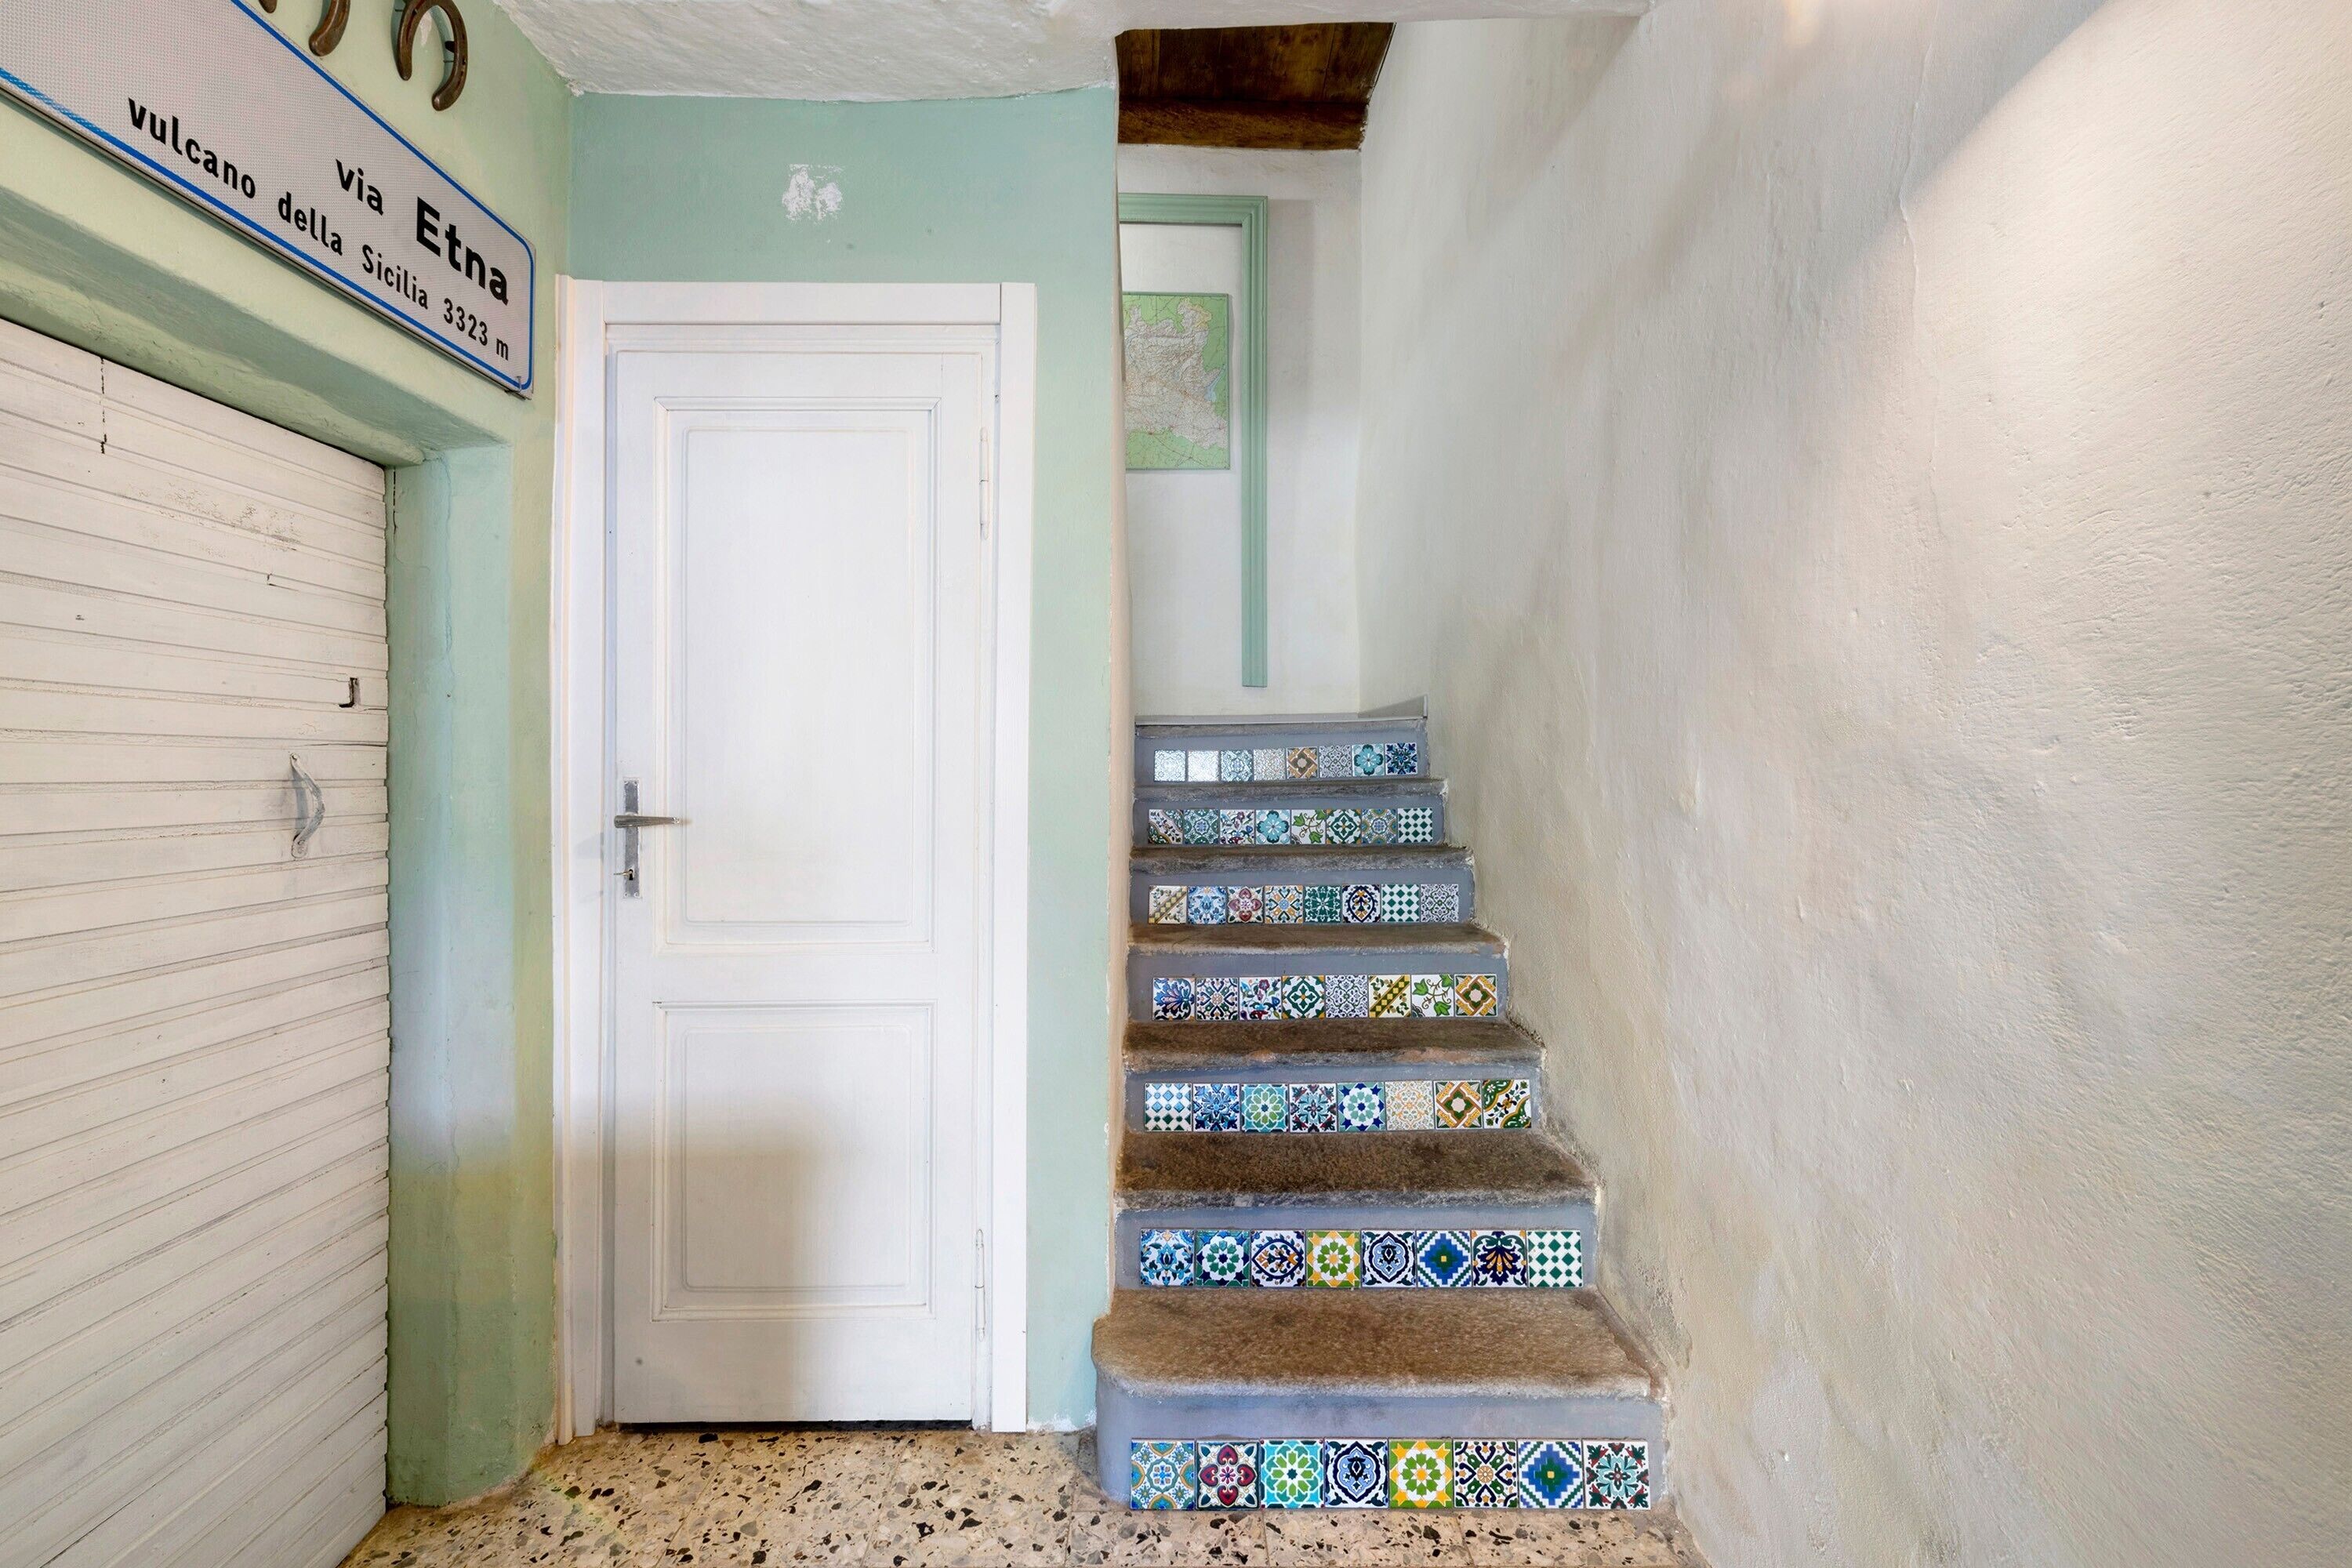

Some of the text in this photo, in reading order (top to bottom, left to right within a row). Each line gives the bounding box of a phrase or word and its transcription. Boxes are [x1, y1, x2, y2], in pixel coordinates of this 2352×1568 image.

[128, 97, 509, 361] vulcano della Sicilia 3323 m
[336, 159, 509, 305] via Etna
